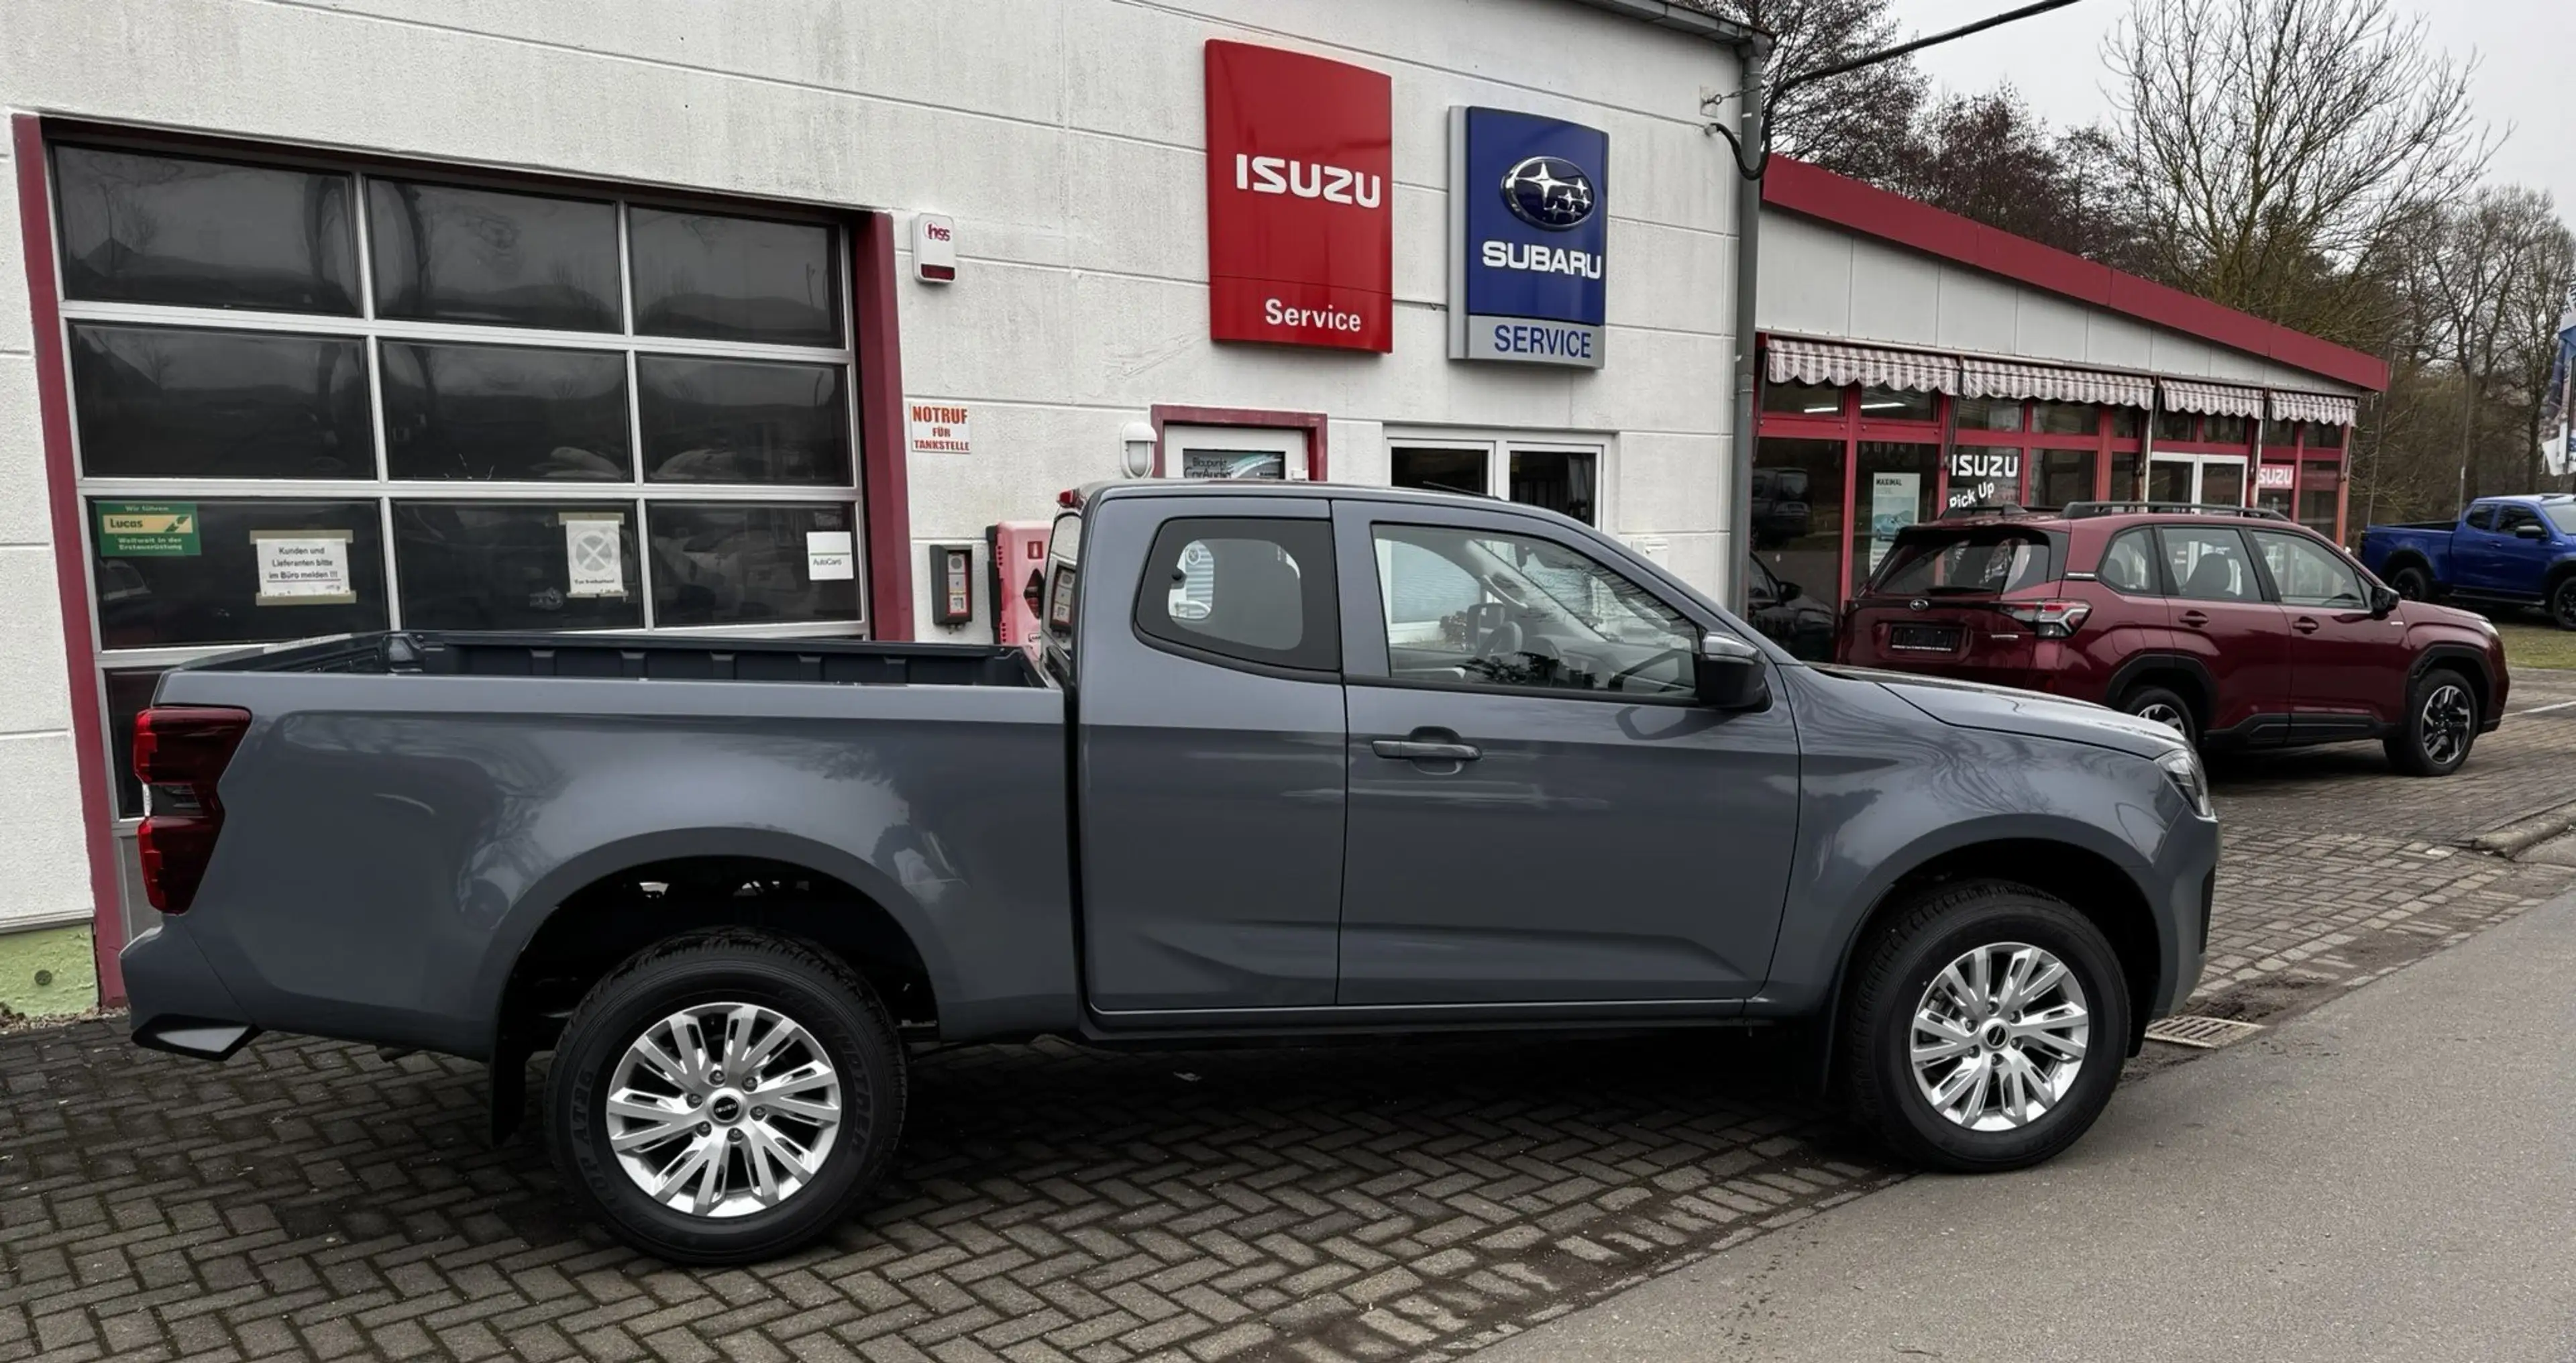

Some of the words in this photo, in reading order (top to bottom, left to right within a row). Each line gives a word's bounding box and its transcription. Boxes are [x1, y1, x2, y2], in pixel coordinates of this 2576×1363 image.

[1236, 154, 1381, 209] ISUZU
[928, 223, 951, 241] hss
[1482, 240, 1602, 279] SUBARU
[1265, 298, 1362, 332] Service
[1494, 324, 1592, 359] SERVICE
[912, 406, 967, 424] NOTRUF
[932, 426, 951, 437] FÜR
[914, 439, 970, 451] TANKSTELLE
[1951, 454, 2018, 478] ISUZU
[1876, 478, 1902, 486] MAXIMAL
[2258, 468, 2294, 486] SUZU
[1949, 488, 1976, 508] Pick
[1978, 482, 1994, 499] Up
[109, 518, 144, 529] Lucas
[278, 547, 309, 555] Kunden
[310, 547, 325, 555] und
[272, 559, 315, 567] Lieferanten
[316, 559, 333, 567] bitte
[280, 571, 299, 580] Büro
[301, 571, 328, 579] melden
